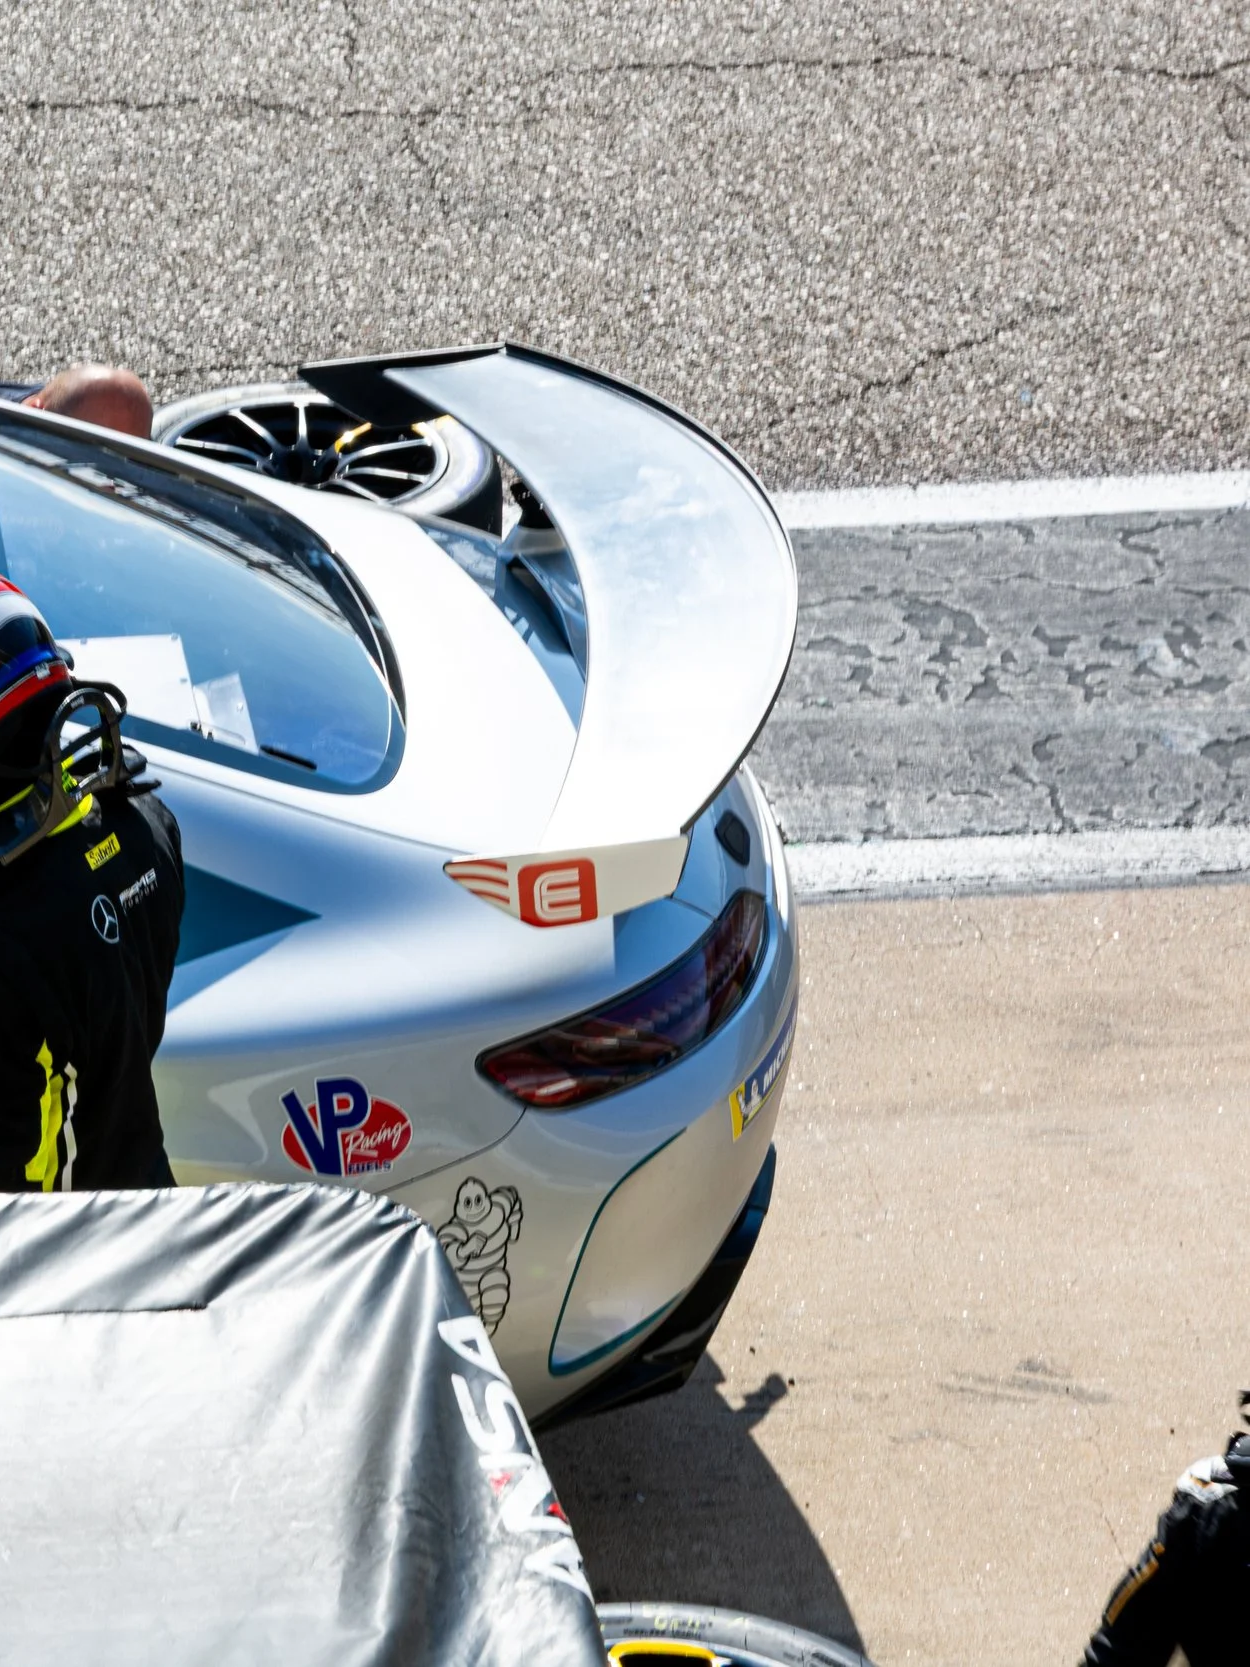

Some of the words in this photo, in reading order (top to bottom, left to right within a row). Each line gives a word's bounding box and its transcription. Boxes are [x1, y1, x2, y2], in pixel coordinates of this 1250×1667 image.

[280, 1076, 370, 1176] VP
[344, 1120, 410, 1162] Racing
[348, 1160, 392, 1174] FUELS
